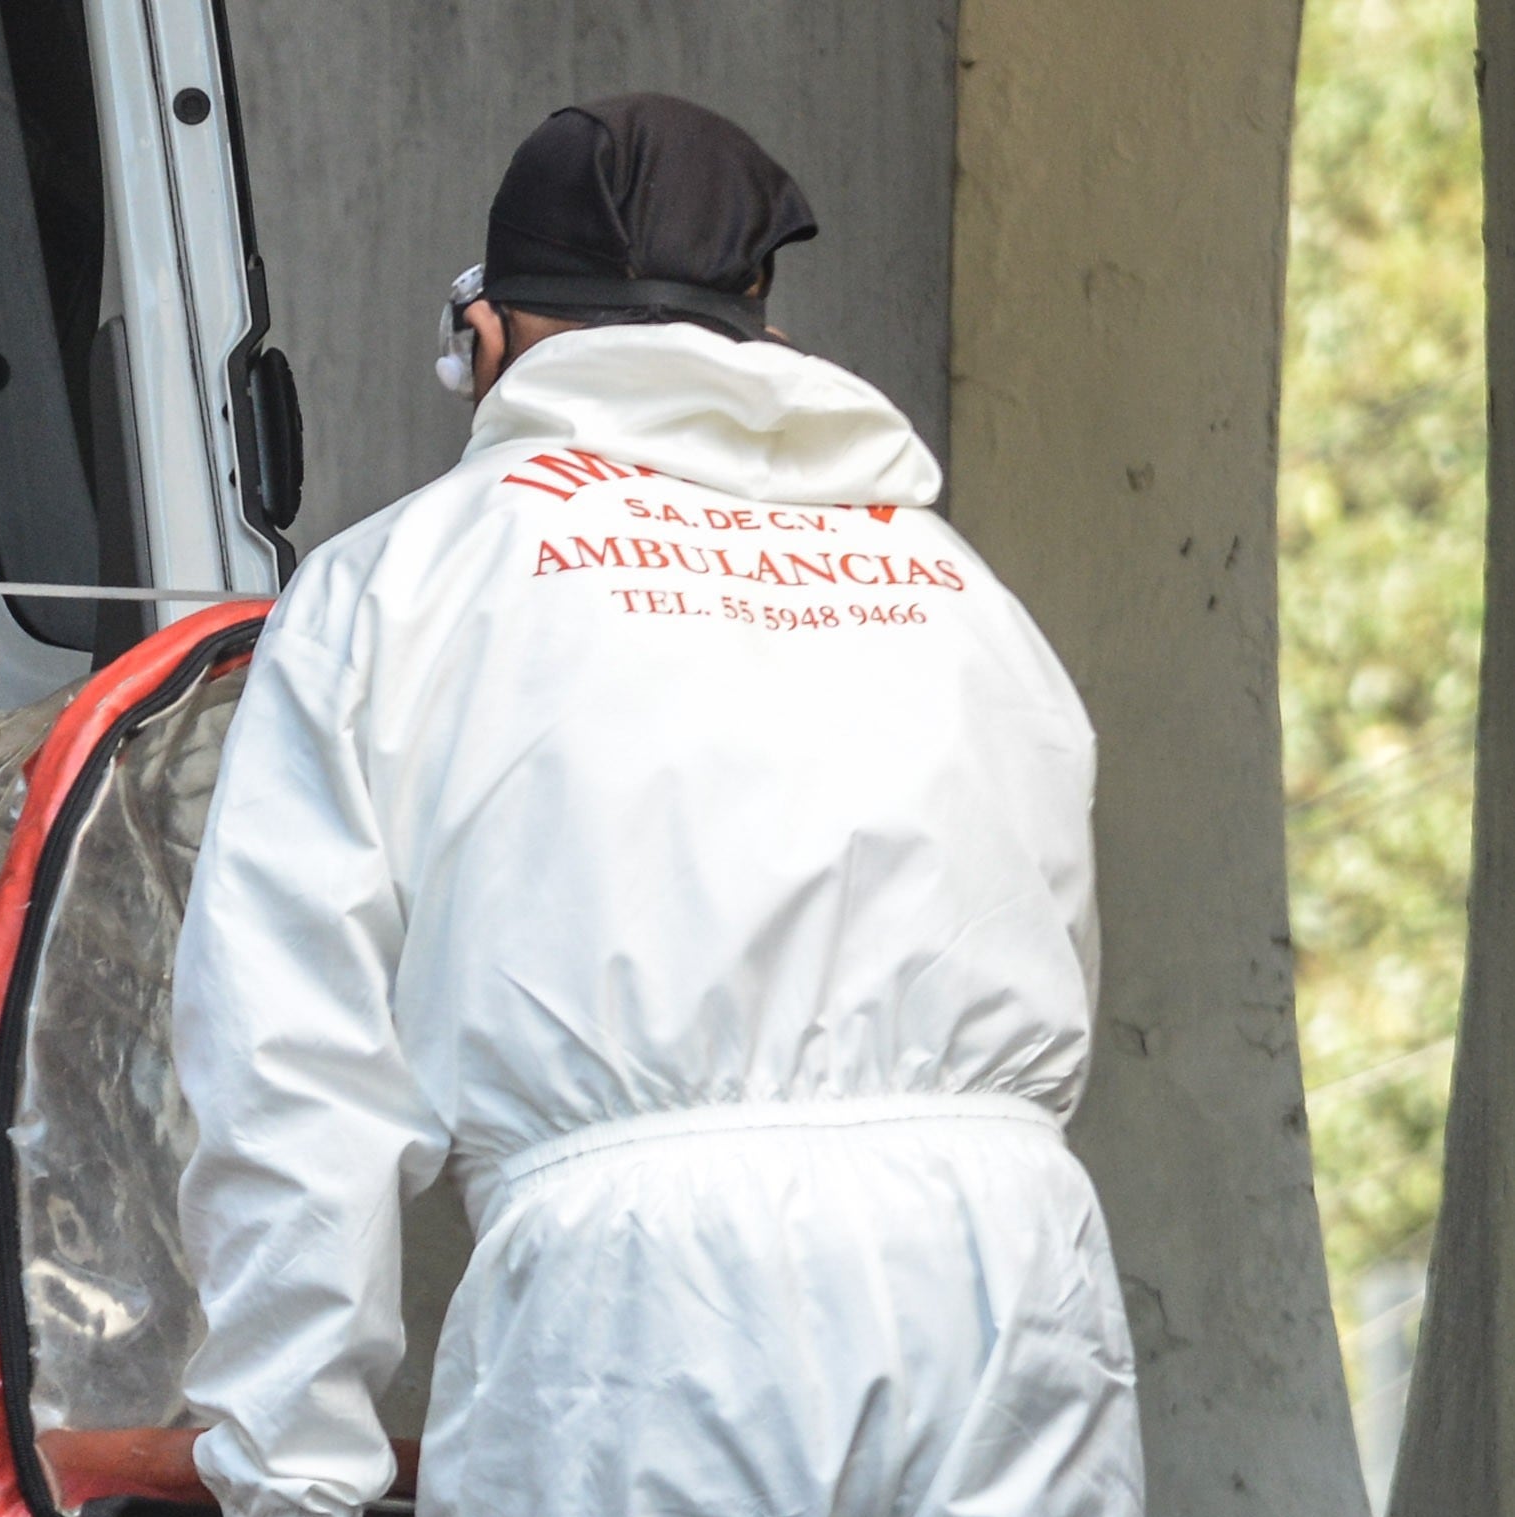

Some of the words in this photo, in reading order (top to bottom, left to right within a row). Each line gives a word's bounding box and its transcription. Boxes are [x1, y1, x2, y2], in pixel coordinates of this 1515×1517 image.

[703, 508, 761, 530] DE
[767, 511, 838, 533] C.V.
[532, 537, 965, 592] AMBULANCIAS
[611, 588, 711, 616] TEL.
[721, 595, 755, 624] 55
[763, 605, 840, 632] 5948
[848, 603, 927, 626] 9466
